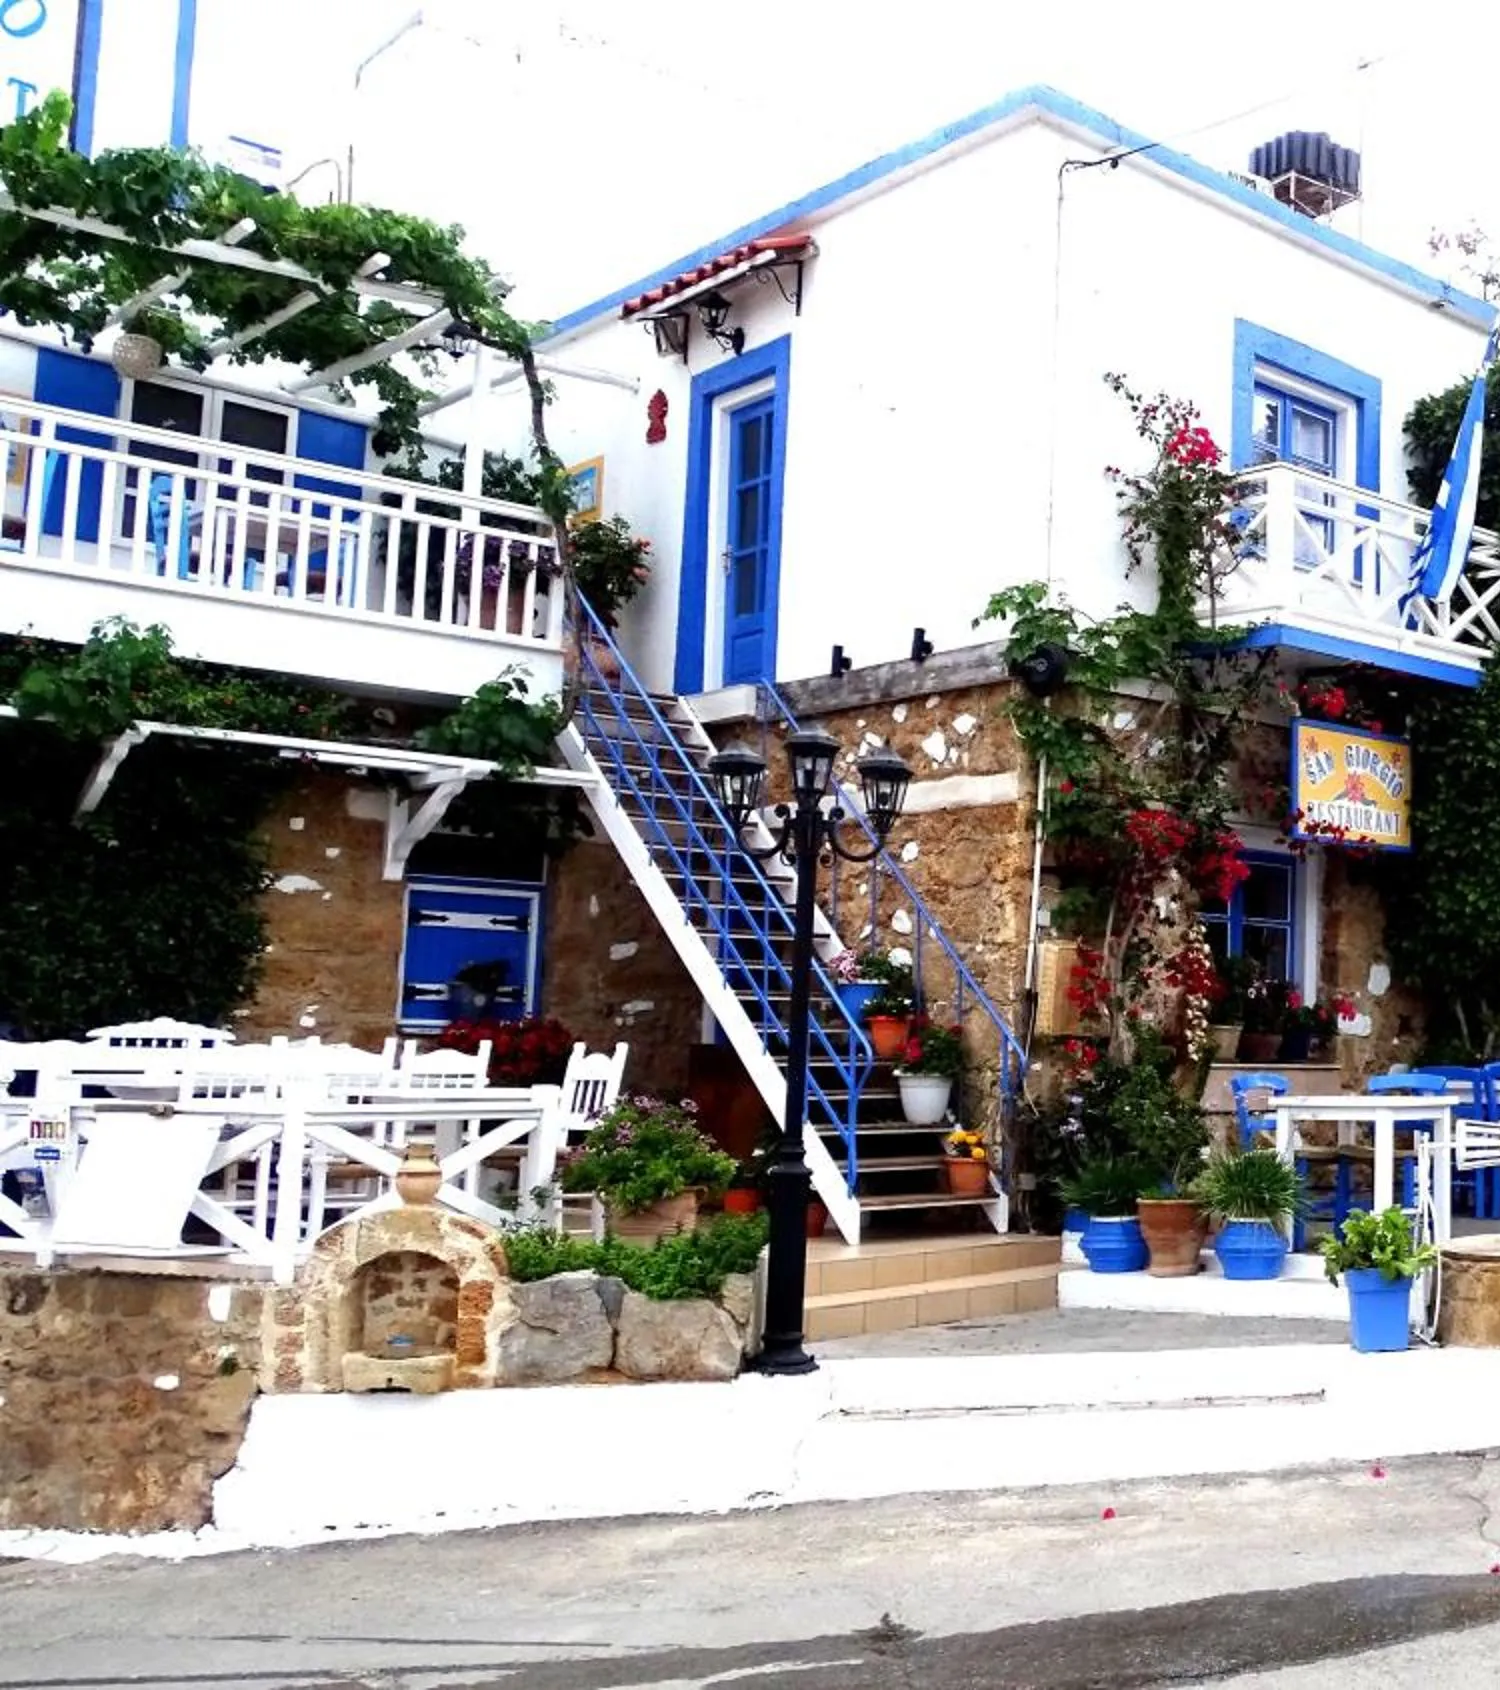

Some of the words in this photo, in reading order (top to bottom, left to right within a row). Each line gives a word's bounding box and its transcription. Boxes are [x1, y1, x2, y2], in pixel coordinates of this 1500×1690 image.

[1304, 751, 1334, 785] SAN
[1344, 745, 1404, 798] GIORGIO
[1307, 801, 1400, 835] RESTAURANT
